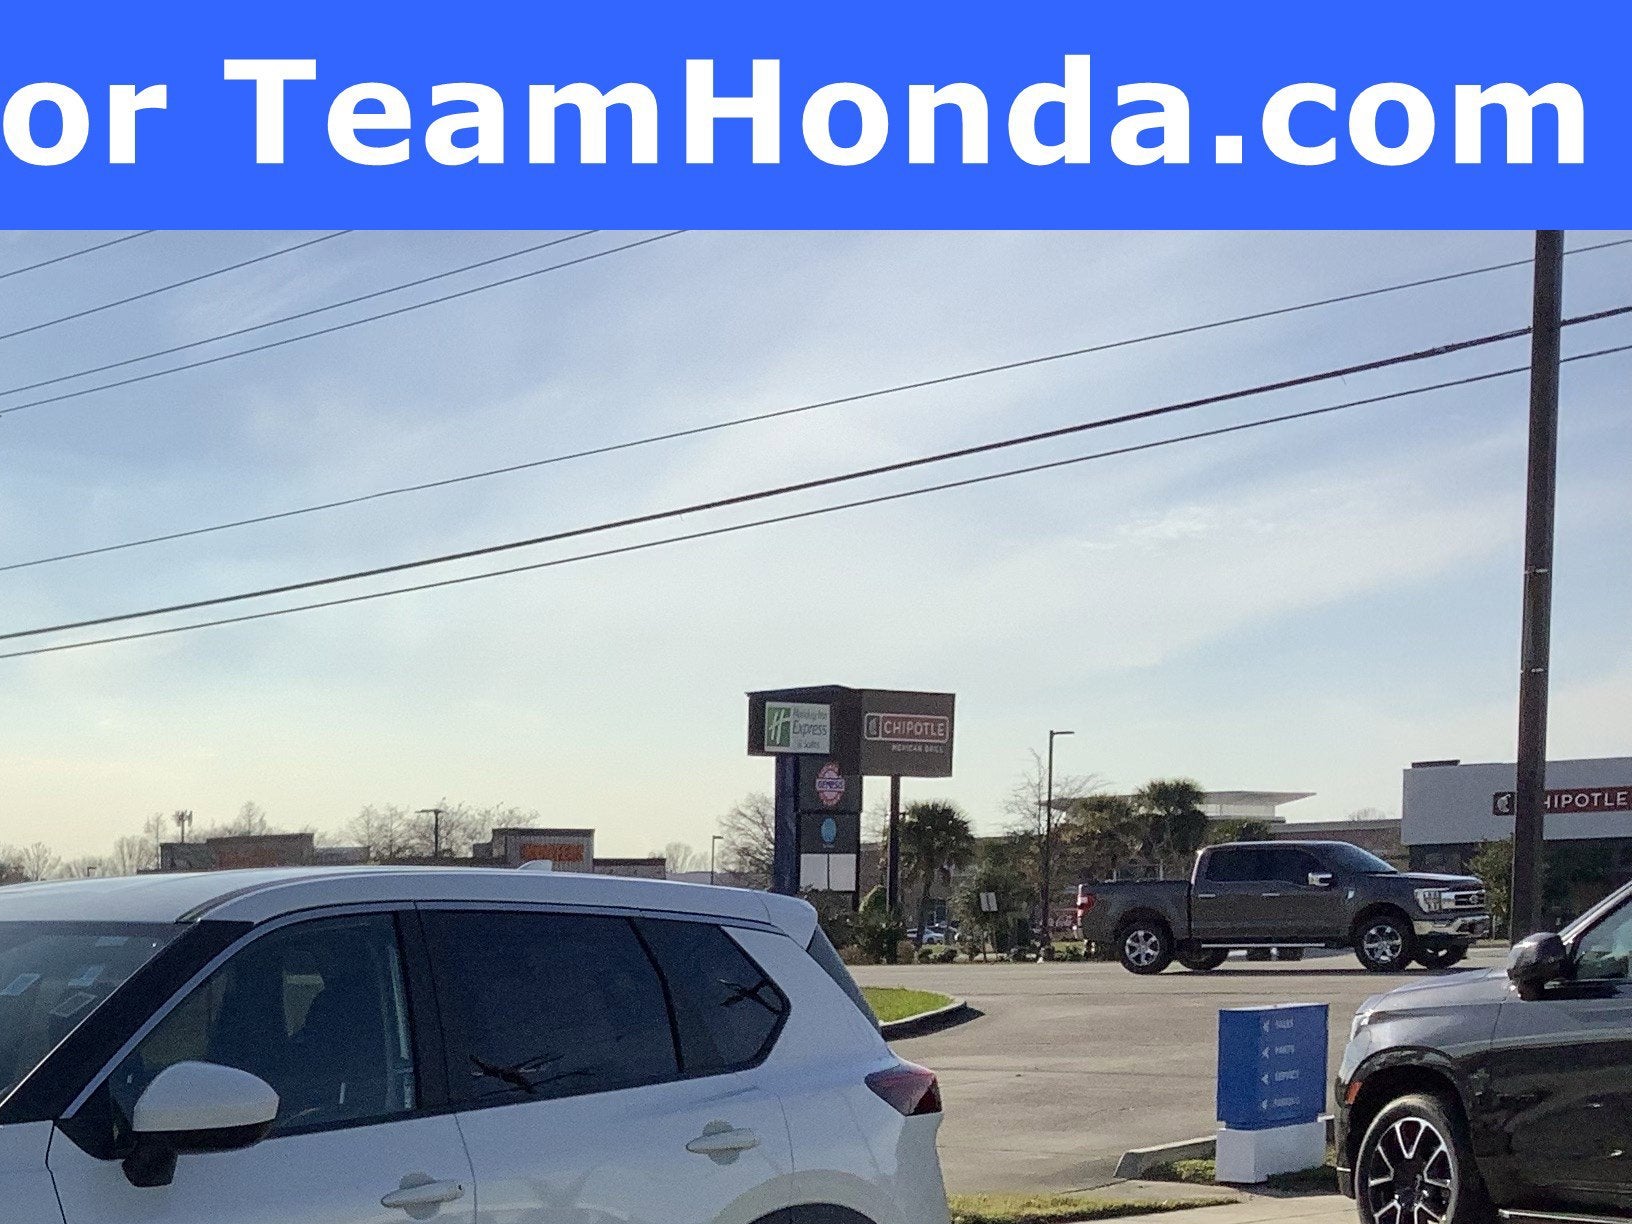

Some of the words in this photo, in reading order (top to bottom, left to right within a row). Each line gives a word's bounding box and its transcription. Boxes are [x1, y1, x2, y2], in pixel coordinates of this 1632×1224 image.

[793, 720, 828, 737] Express
[883, 720, 945, 737] CHIPOTLE
[1544, 791, 1629, 809] HIPOTLE
